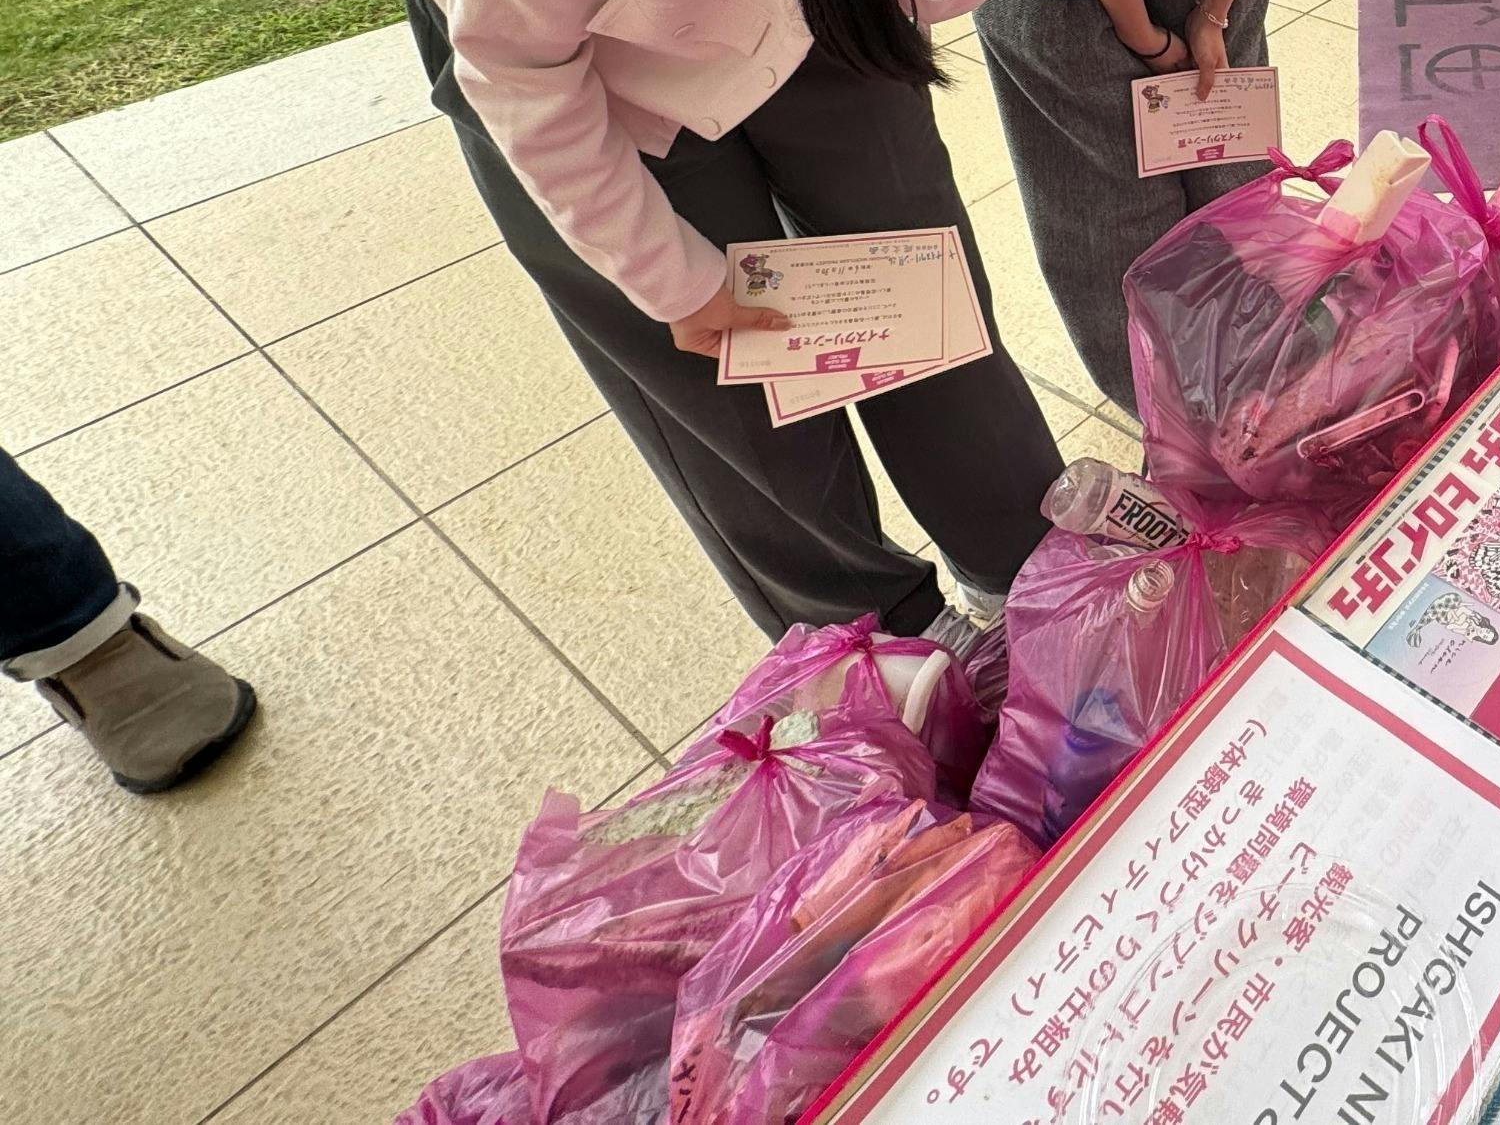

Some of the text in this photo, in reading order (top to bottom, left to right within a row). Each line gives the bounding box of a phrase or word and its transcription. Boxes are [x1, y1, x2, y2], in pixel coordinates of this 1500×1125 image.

[786, 327, 891, 352] ナイスクリーンで賞
[1328, 472, 1481, 621] ヒロインチュ
[1008, 783, 1266, 1087] きっかけづくりの仕組み
